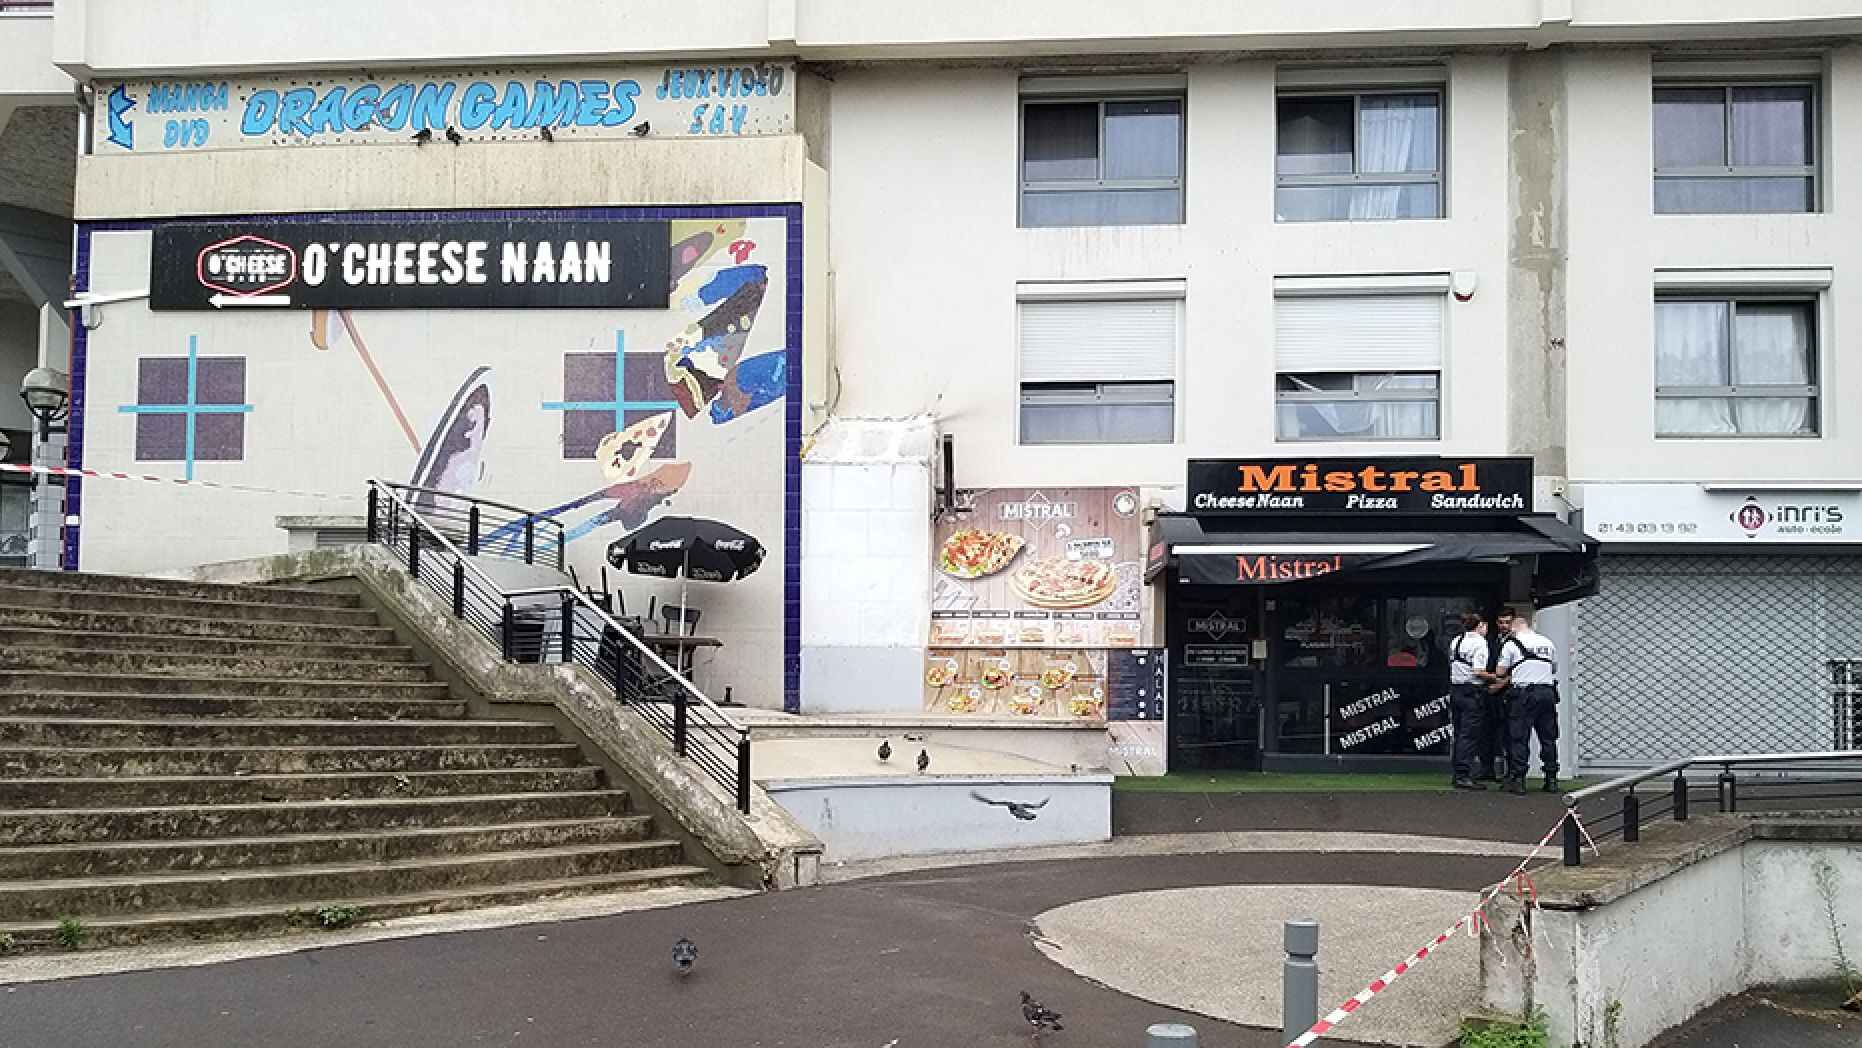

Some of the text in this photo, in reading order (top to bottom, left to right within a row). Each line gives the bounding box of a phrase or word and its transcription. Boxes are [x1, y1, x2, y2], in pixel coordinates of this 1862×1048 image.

[145, 81, 229, 114] MANGA
[241, 79, 641, 138] DRAGON GAMES
[163, 119, 209, 148] DVD
[303, 241, 612, 287] O'CHEESE NAAN
[1237, 463, 1481, 493] Mistral
[1004, 503, 1073, 518] MISTRAL
[1194, 493, 1525, 510] Cheese Naan Pizza Sandwich
[1339, 687, 1401, 720] MISTRAL
[1339, 715, 1401, 750] MISTRAL
